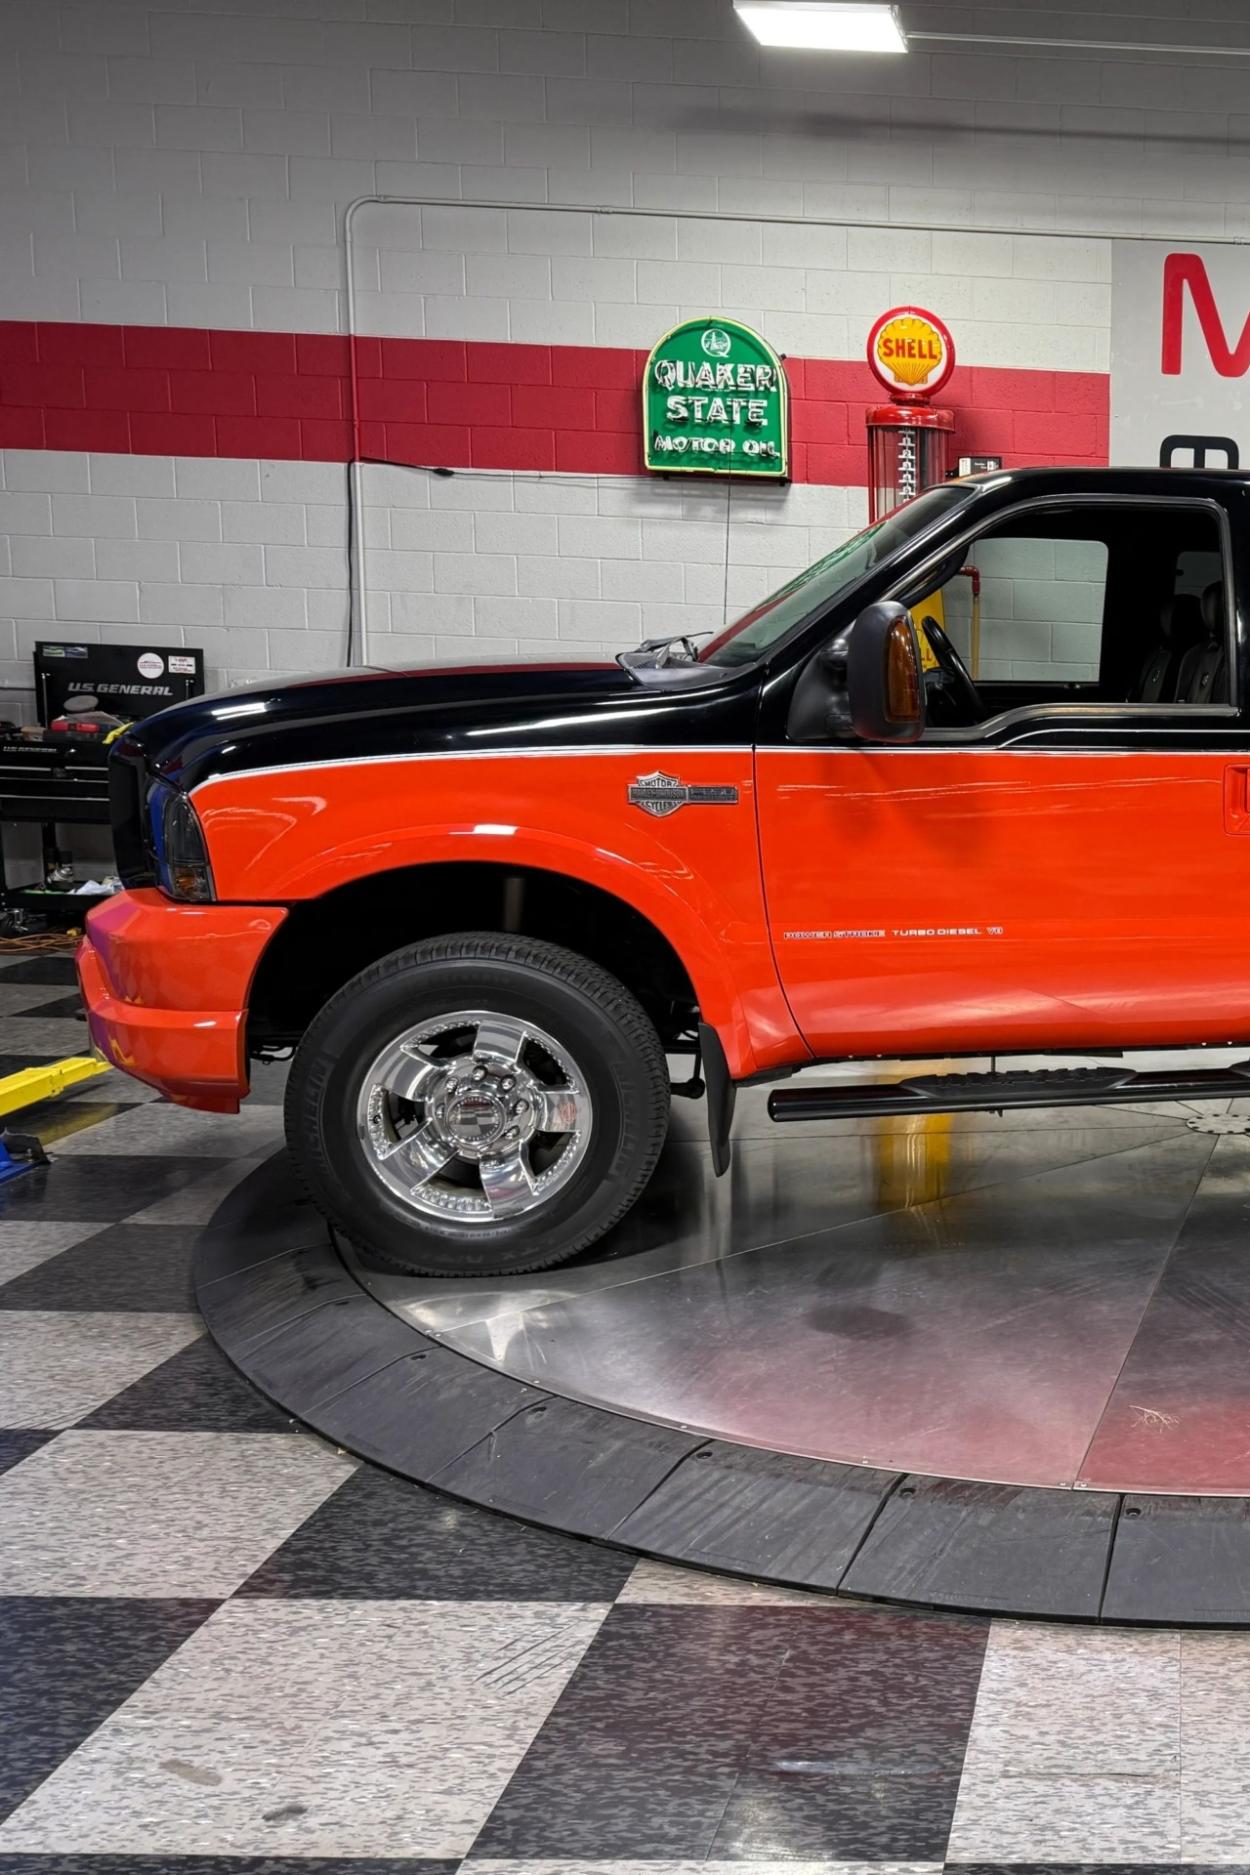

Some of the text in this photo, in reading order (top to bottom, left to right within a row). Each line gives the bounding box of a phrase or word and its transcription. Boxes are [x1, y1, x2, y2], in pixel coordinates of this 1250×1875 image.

[883, 338, 937, 359] SHELL
[654, 360, 777, 392] QUAKER
[666, 395, 768, 426] STATE
[654, 435, 781, 458] MOTOR OIL
[97, 684, 174, 696] GENERAL
[892, 929, 935, 937] TURBO
[937, 927, 982, 936] DIESEL
